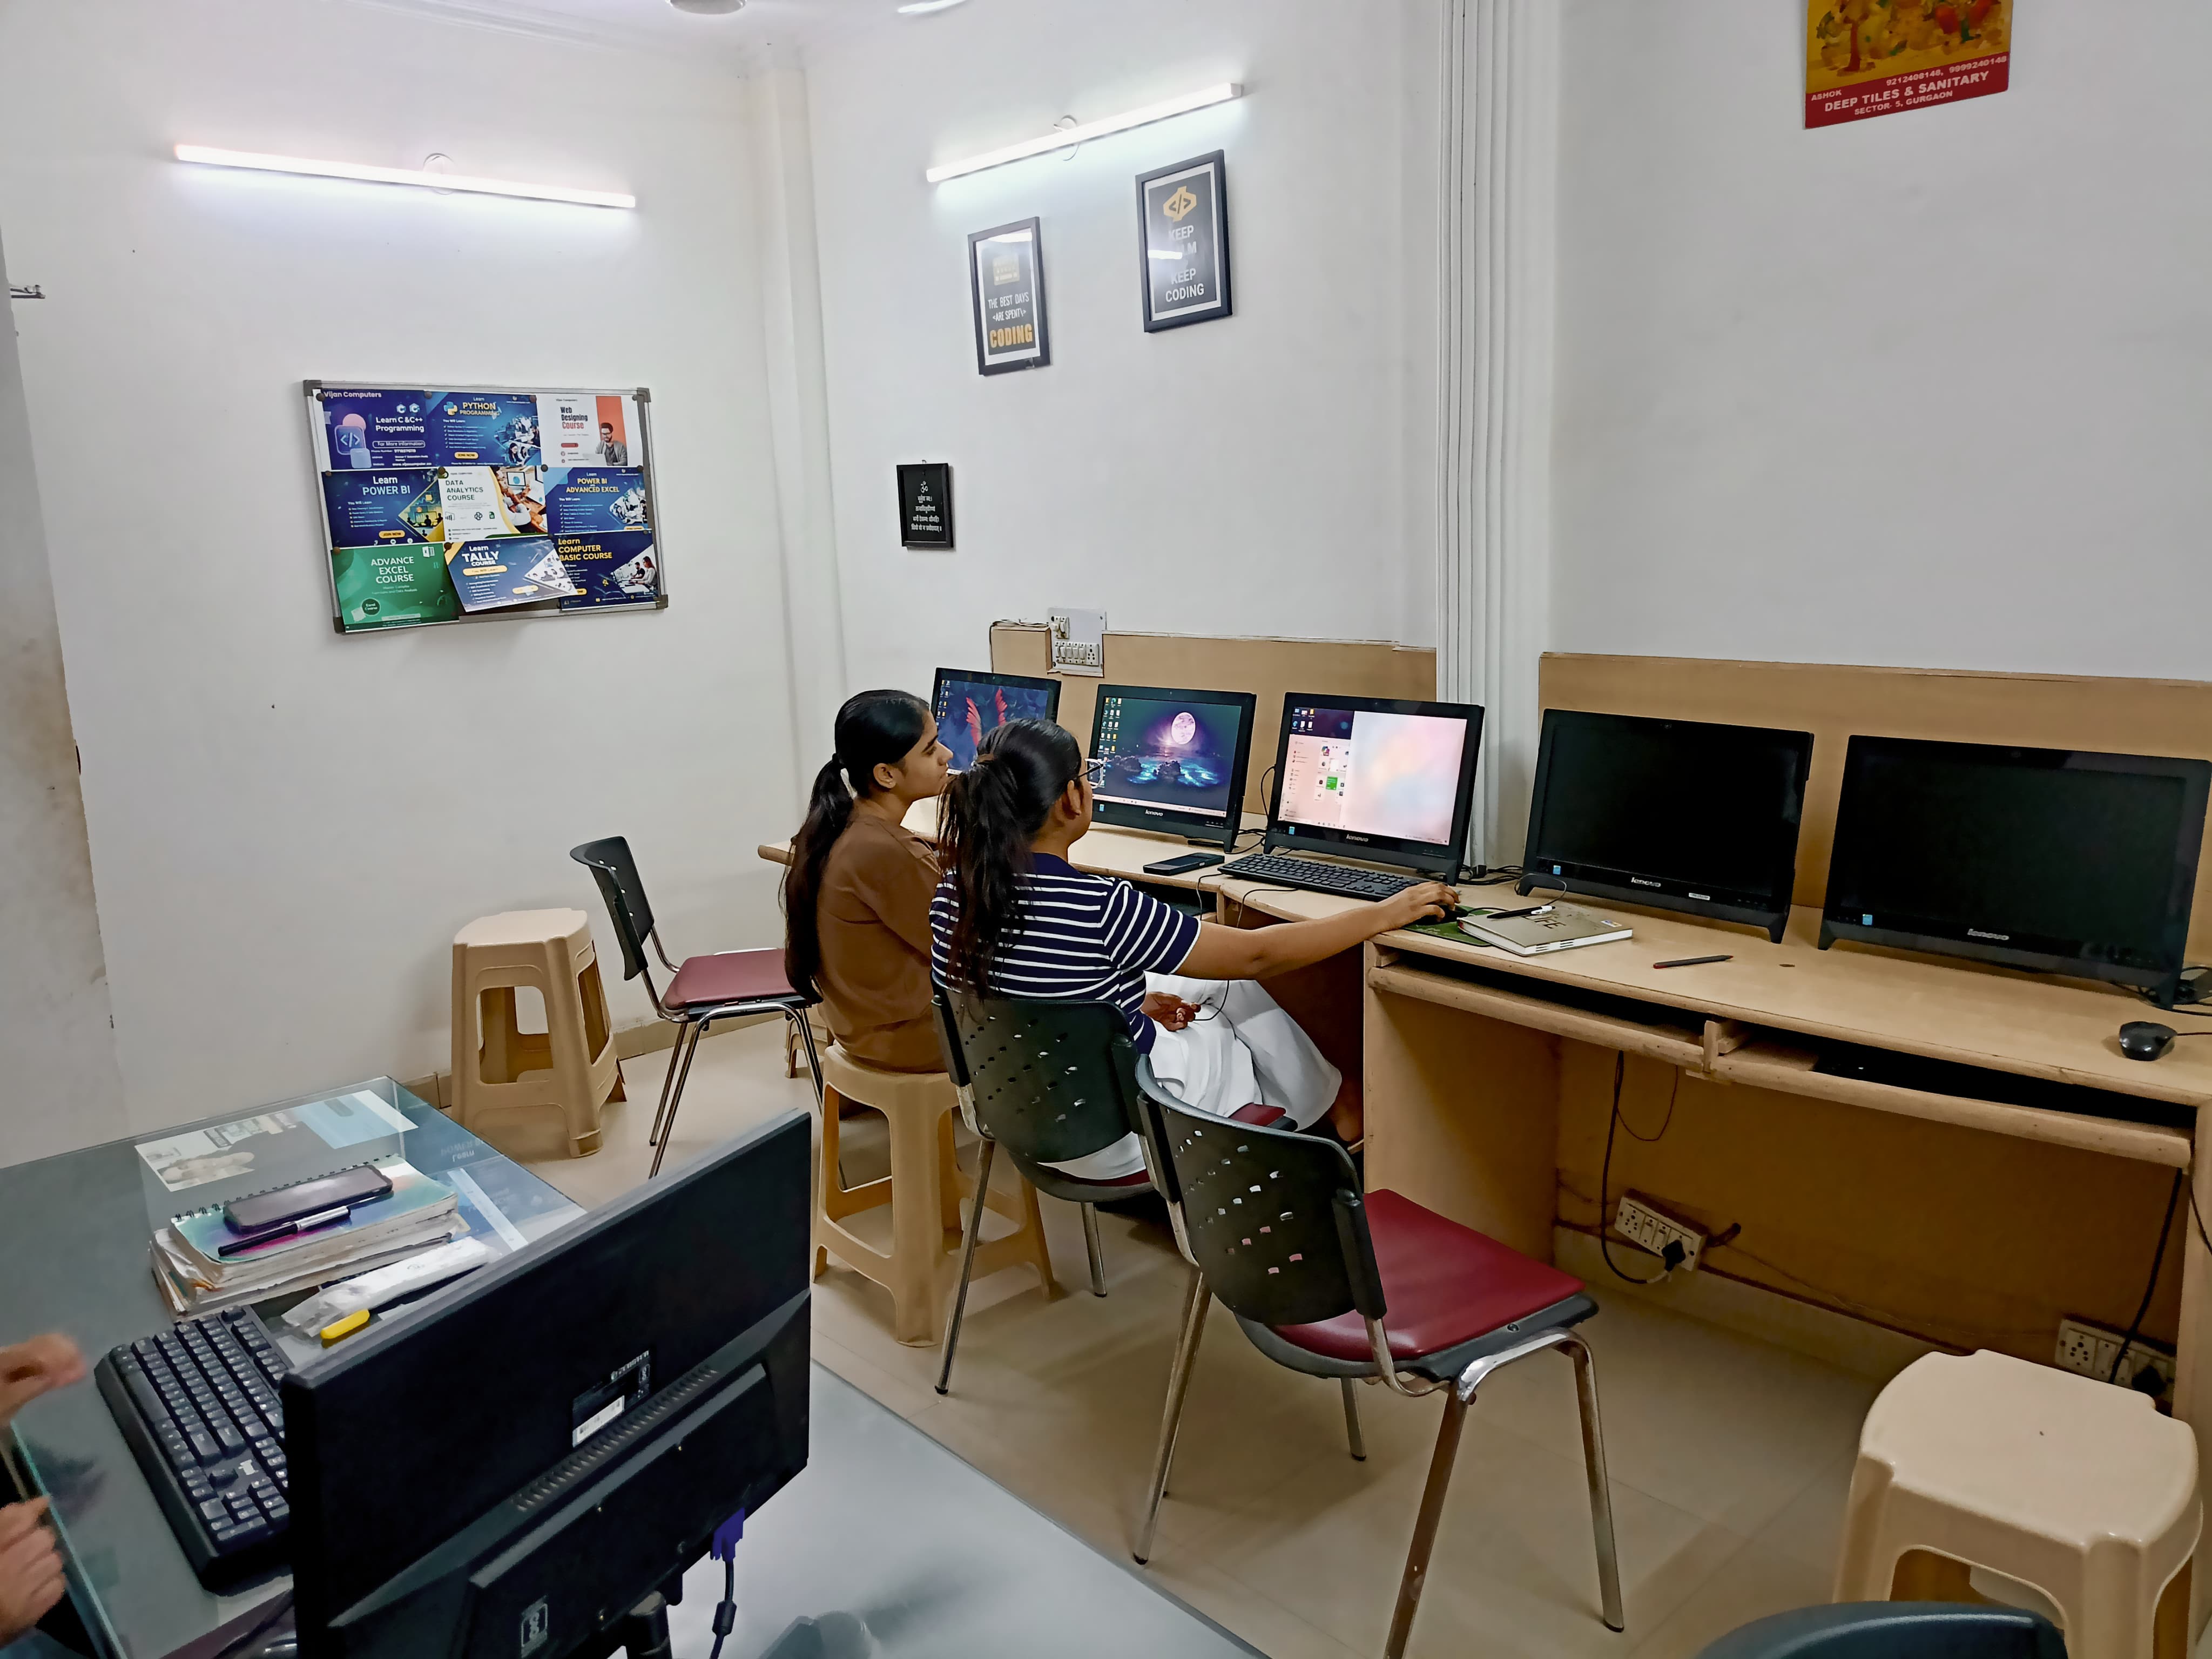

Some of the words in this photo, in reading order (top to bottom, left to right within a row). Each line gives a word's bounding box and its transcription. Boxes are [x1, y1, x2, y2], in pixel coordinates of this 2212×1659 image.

[1811, 90, 1842, 101] ASHOK
[1825, 97, 1858, 112] DEEP
[1862, 89, 1900, 104] TILES
[1904, 86, 1914, 96] &
[1919, 71, 1990, 93] SANITARY
[1906, 90, 1953, 106] GURGAON
[1169, 225, 1194, 241] KEEP
[1171, 268, 1197, 285] KEEP
[1165, 284, 1205, 302] CODING
[988, 299, 999, 309] THE
[1000, 295, 1013, 307] BEST
[1015, 292, 1029, 305] DAYS
[989, 323, 1033, 348] CODING
[463, 402, 496, 410] PYTHON
[562, 421, 584, 429] Course
[373, 476, 398, 485] Learn
[362, 485, 399, 496] POWER
[401, 485, 410, 494] BI
[558, 544, 601, 554] COMPUTER
[371, 556, 415, 567] ADVANCE
[462, 551, 499, 563] TALLY
[559, 553, 582, 561] BASIC
[583, 552, 612, 561] COURSE
[379, 566, 409, 575] EXCEL
[375, 574, 415, 584] COURSE
[1346, 834, 1369, 842] lenovo
[1631, 876, 1662, 888] lenovo
[1967, 928, 2009, 940] lenovo
